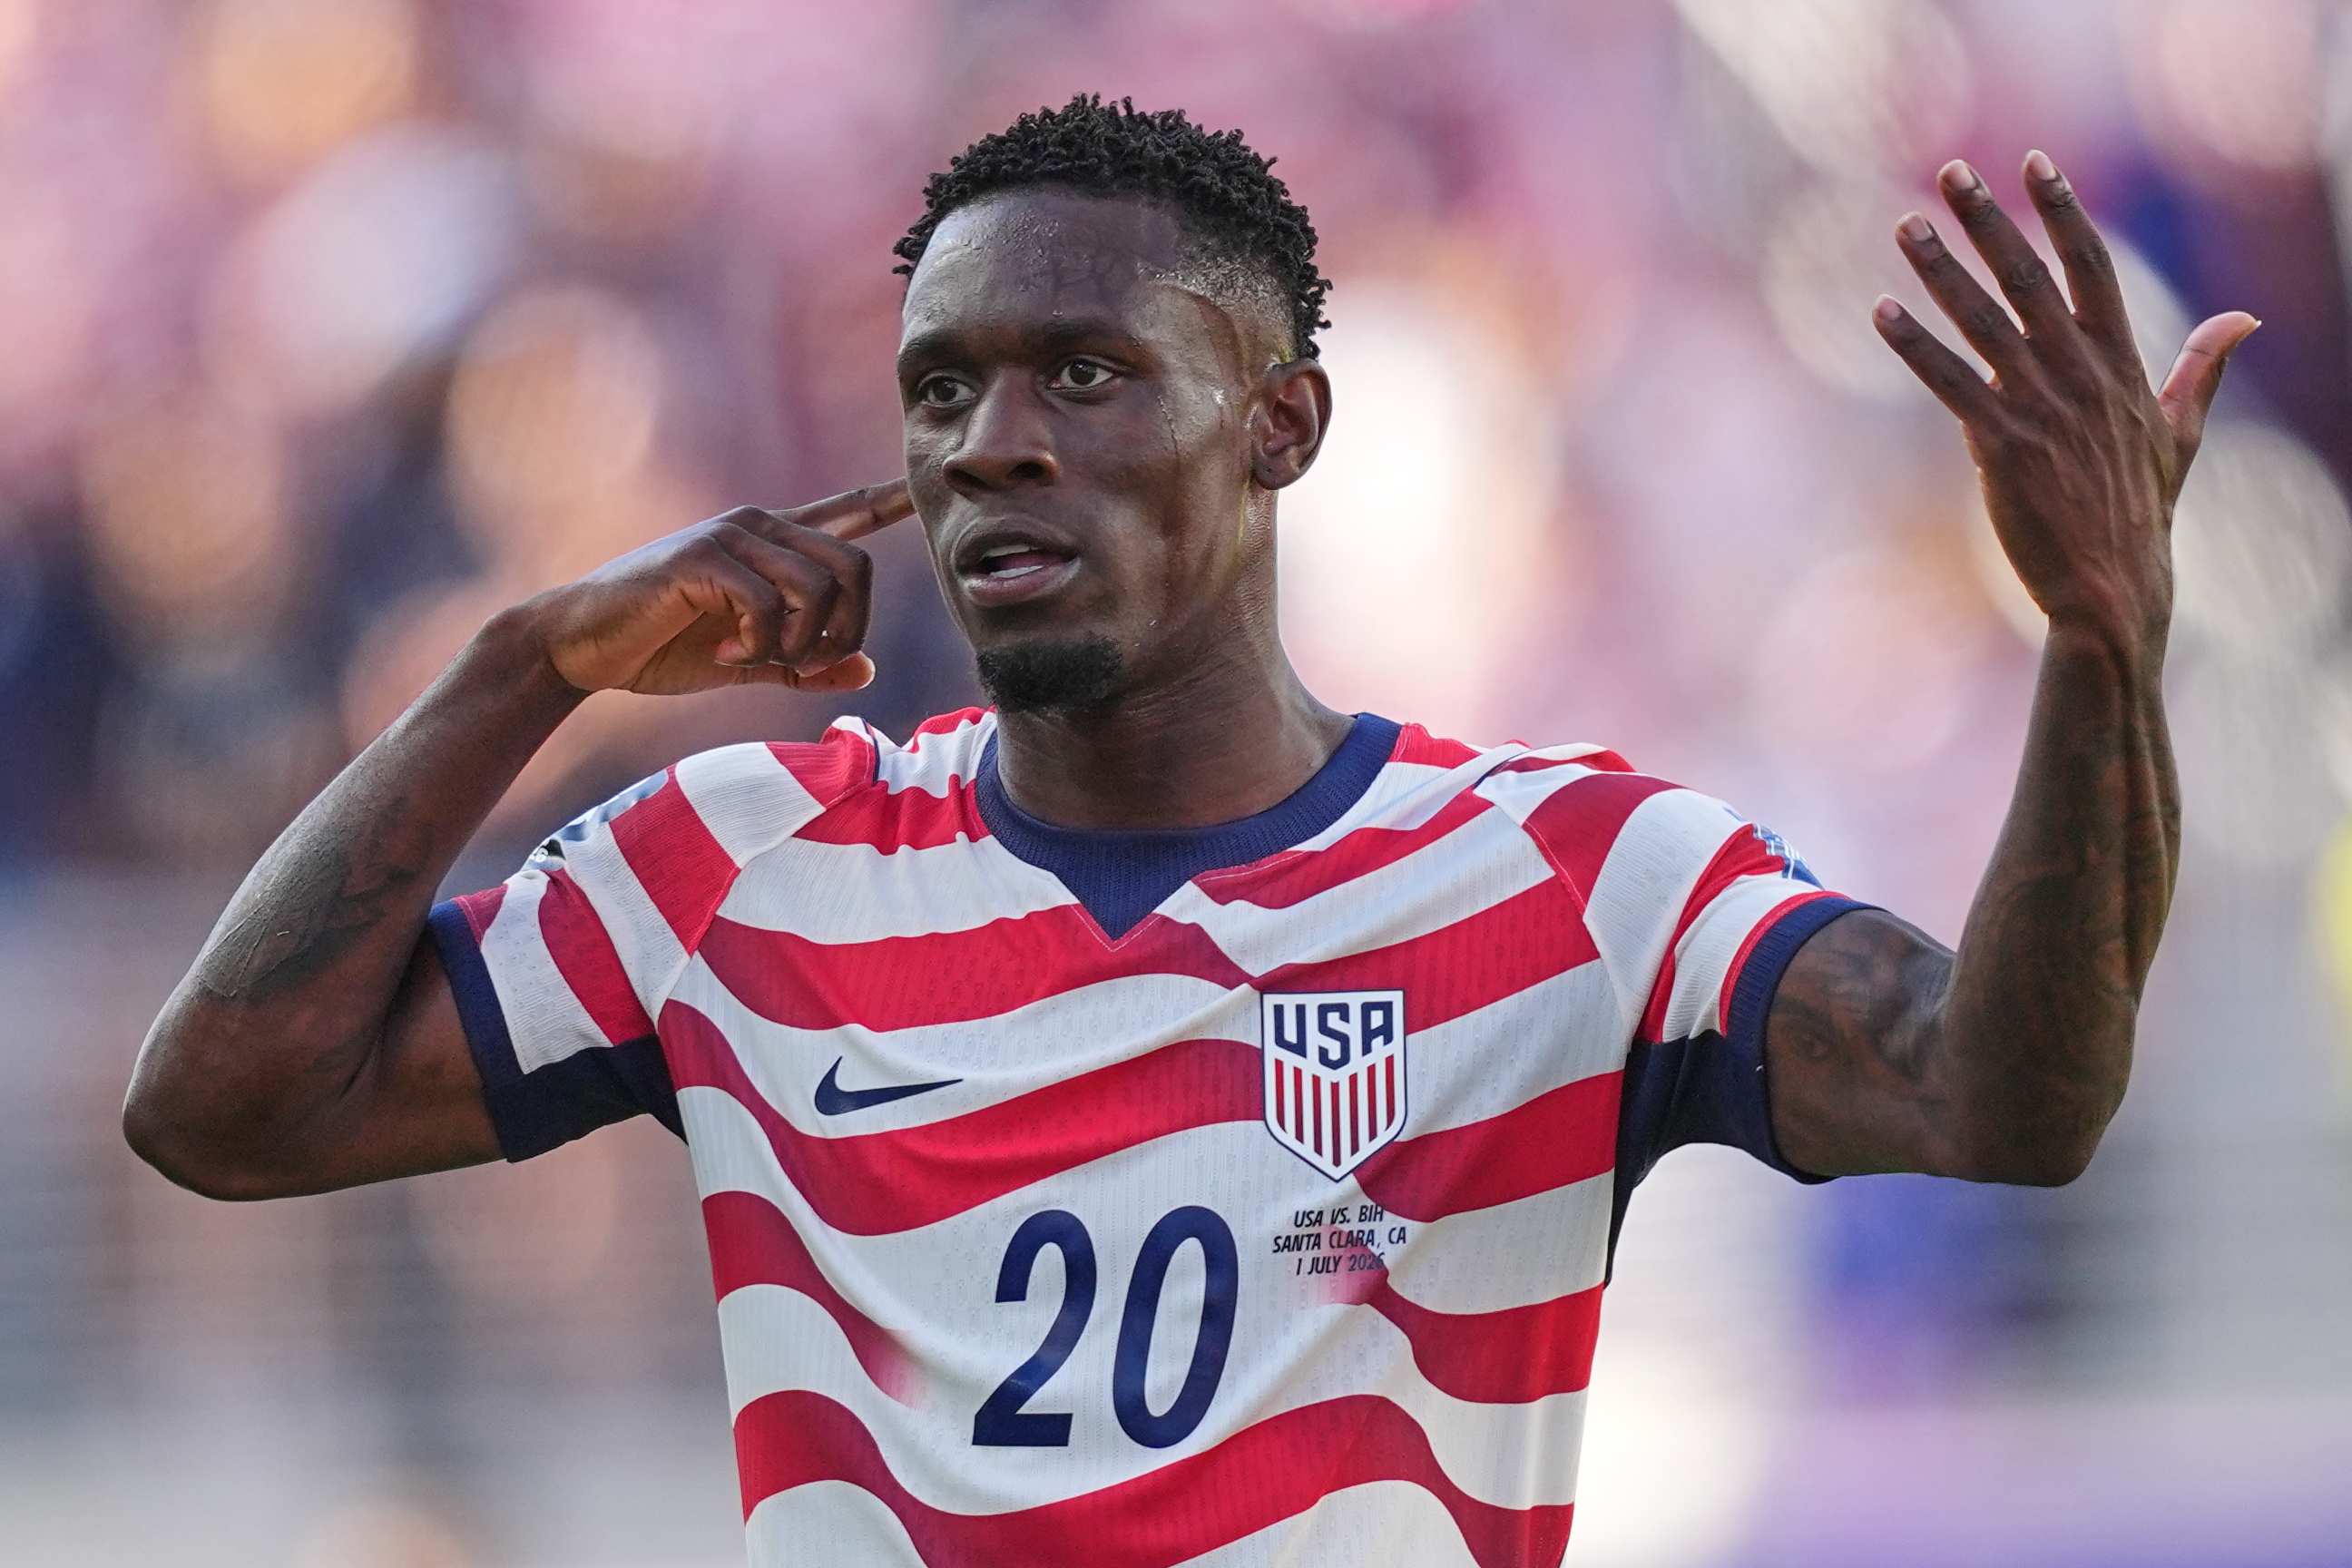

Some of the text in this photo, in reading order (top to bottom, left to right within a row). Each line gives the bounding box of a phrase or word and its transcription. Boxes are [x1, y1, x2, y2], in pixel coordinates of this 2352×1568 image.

[1273, 1001, 1394, 1071] USA
[1294, 1204, 1385, 1228] USA VS. BIH
[1272, 1226, 1406, 1253] SANTA CLARA, CA
[1307, 1255, 1343, 1275] JULY
[1348, 1252, 1386, 1272] 2026
[972, 1205, 1239, 1449] 20
